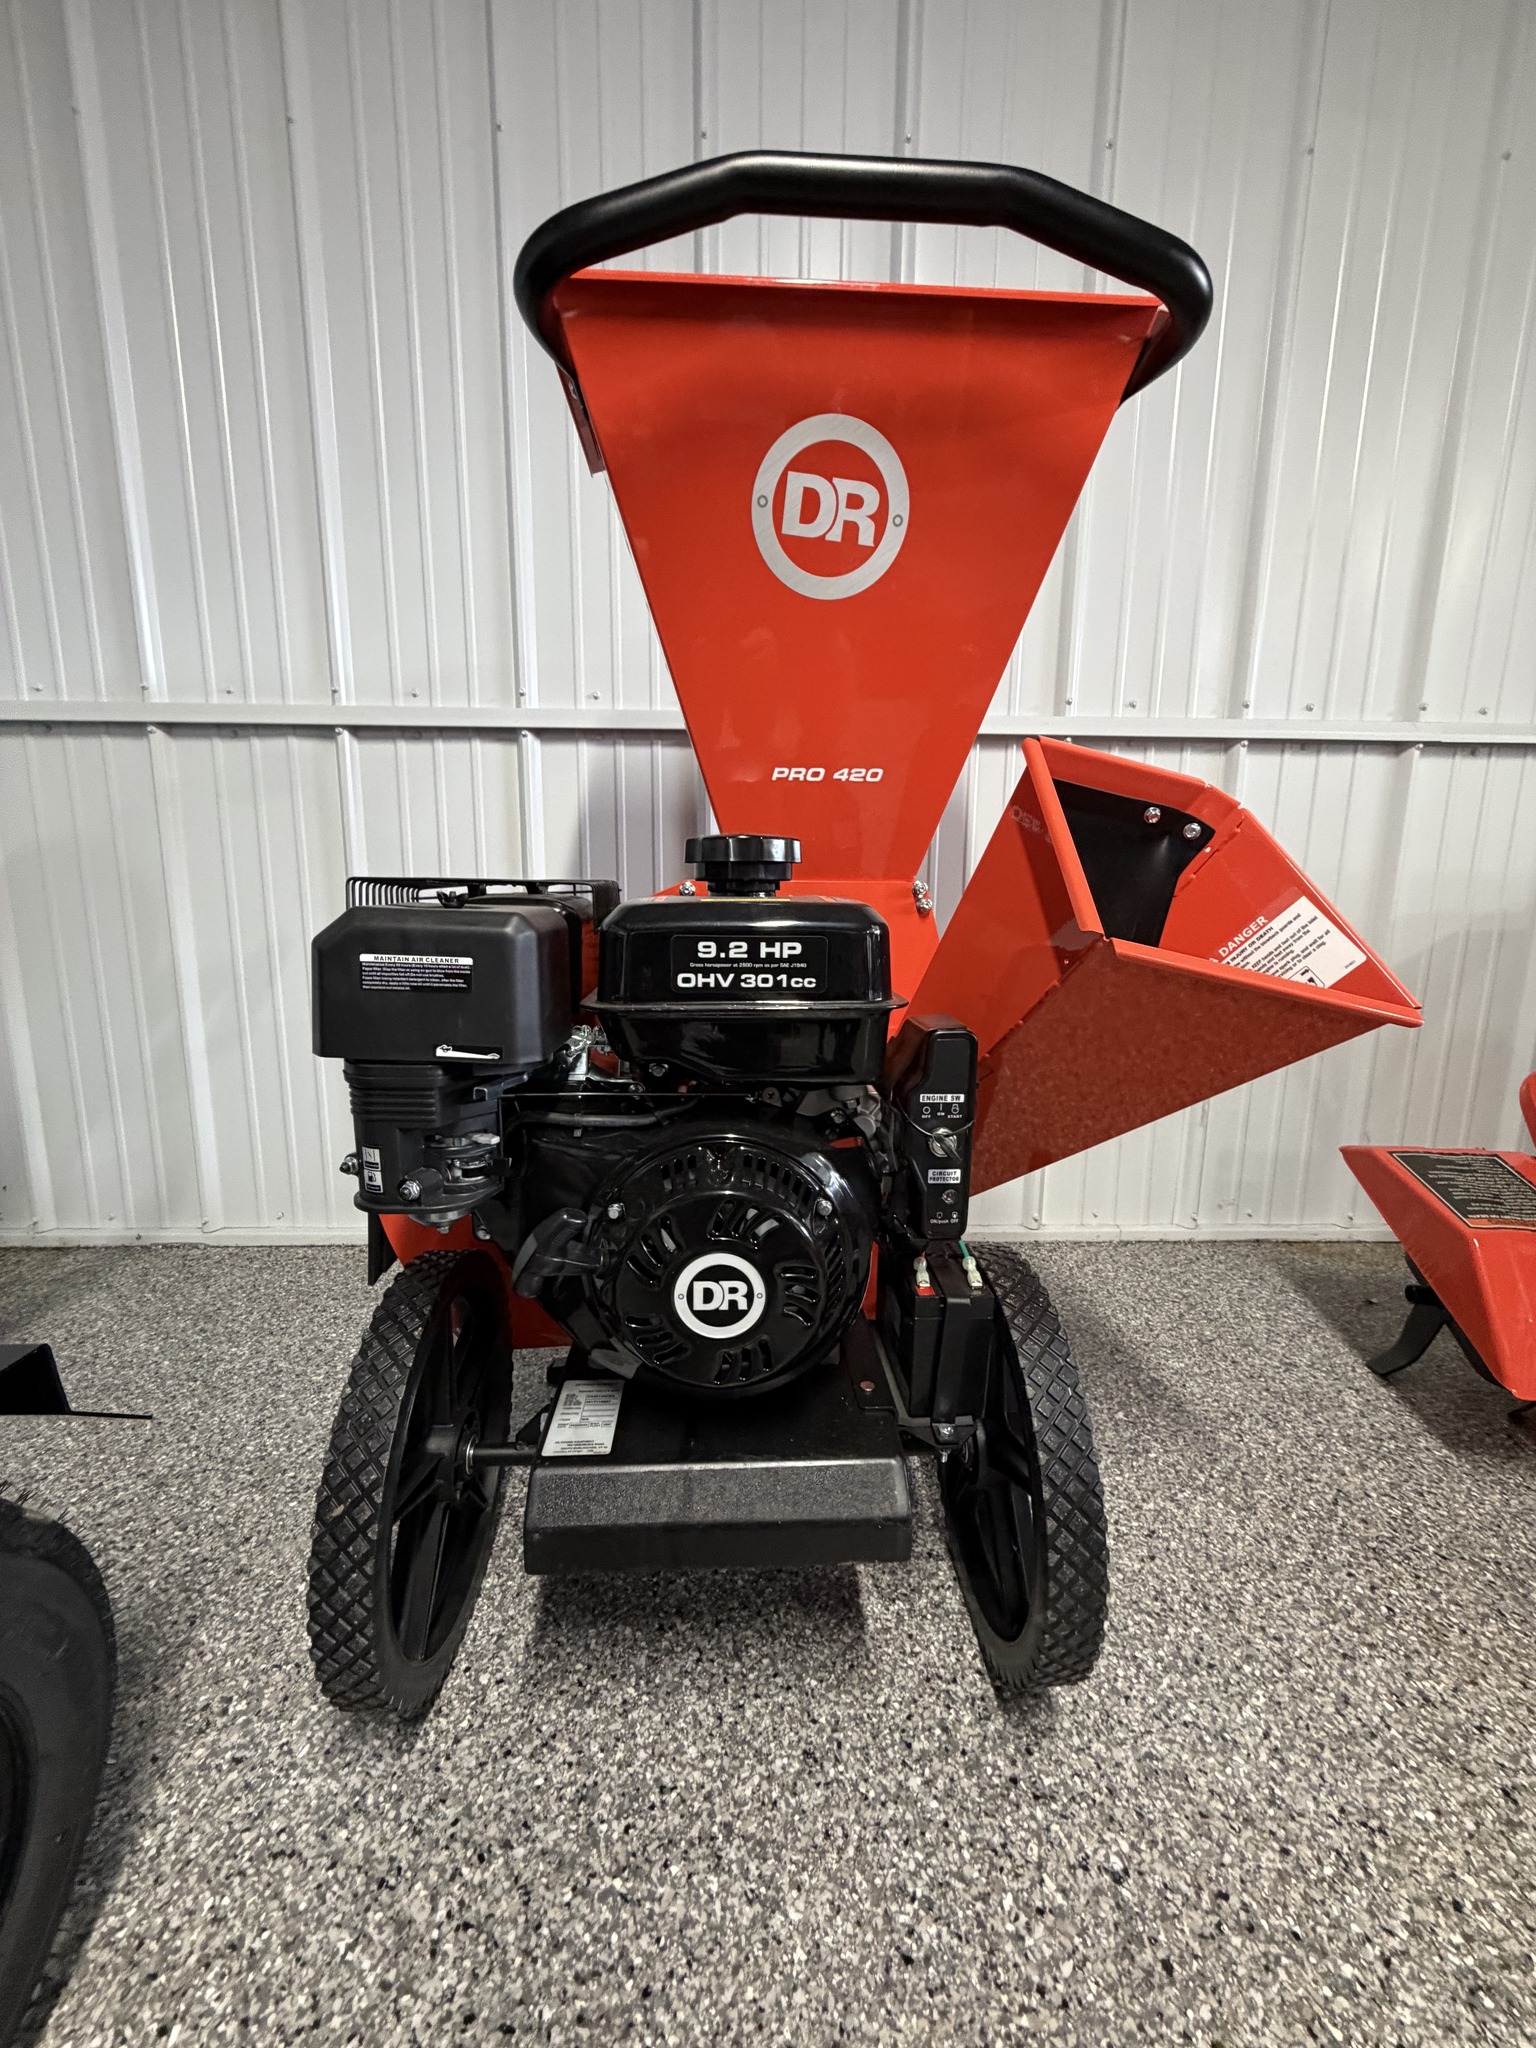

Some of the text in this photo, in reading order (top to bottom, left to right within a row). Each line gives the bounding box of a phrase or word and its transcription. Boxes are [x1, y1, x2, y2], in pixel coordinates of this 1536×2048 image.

[781, 471, 880, 547] DR
[771, 767, 884, 782] PRO 420
[697, 941, 802, 958] 9.2 HP
[1218, 915, 1269, 958] DANGER
[1231, 926, 1273, 962] INJURY OR DEATH
[677, 973, 817, 988] OHV 301cc
[693, 1281, 748, 1310] DR
